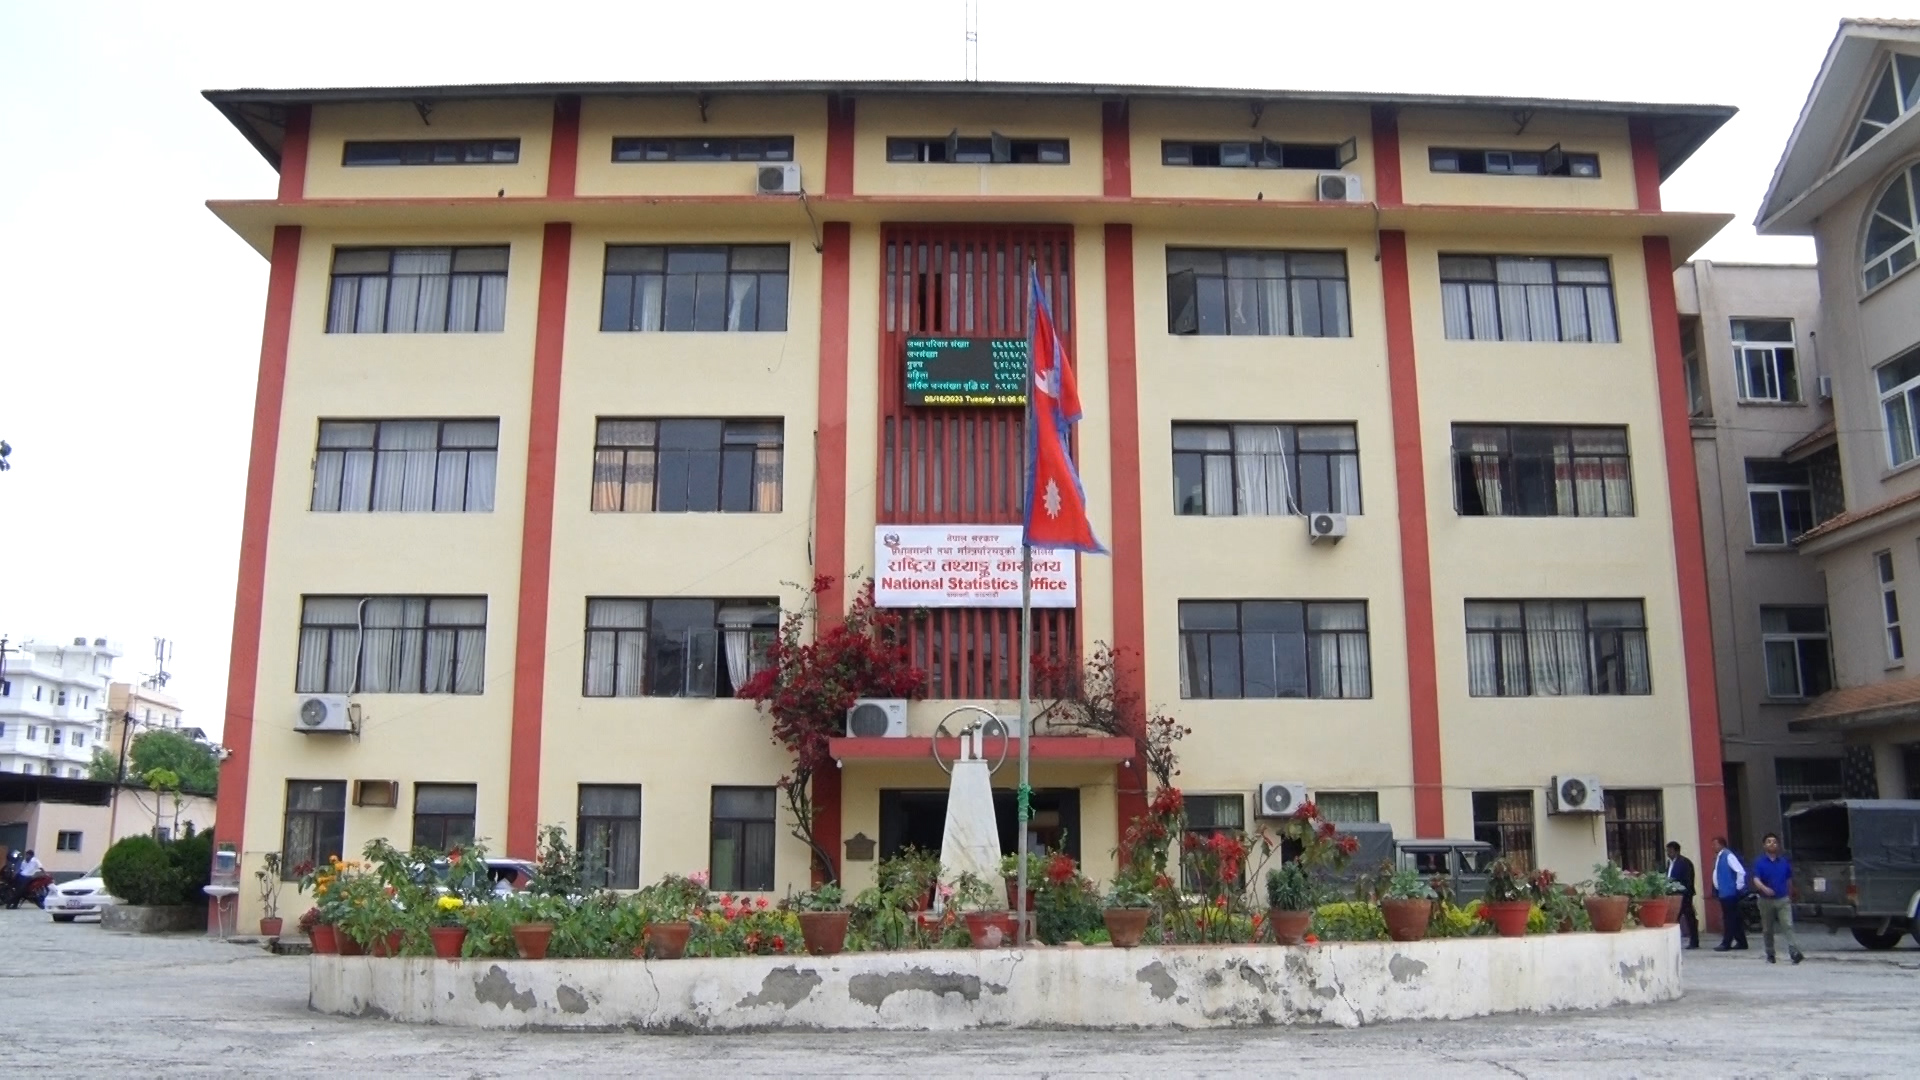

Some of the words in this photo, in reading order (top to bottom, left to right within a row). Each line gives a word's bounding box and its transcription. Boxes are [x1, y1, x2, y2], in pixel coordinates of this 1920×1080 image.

[965, 395, 996, 404] Tuesday
[946, 533, 967, 543] नेपाल
[971, 535, 999, 543] सरकार
[937, 547, 953, 556] तथा
[881, 577, 943, 590] National
[948, 577, 1018, 590] Statistics
[1023, 577, 1067, 590] ffice
